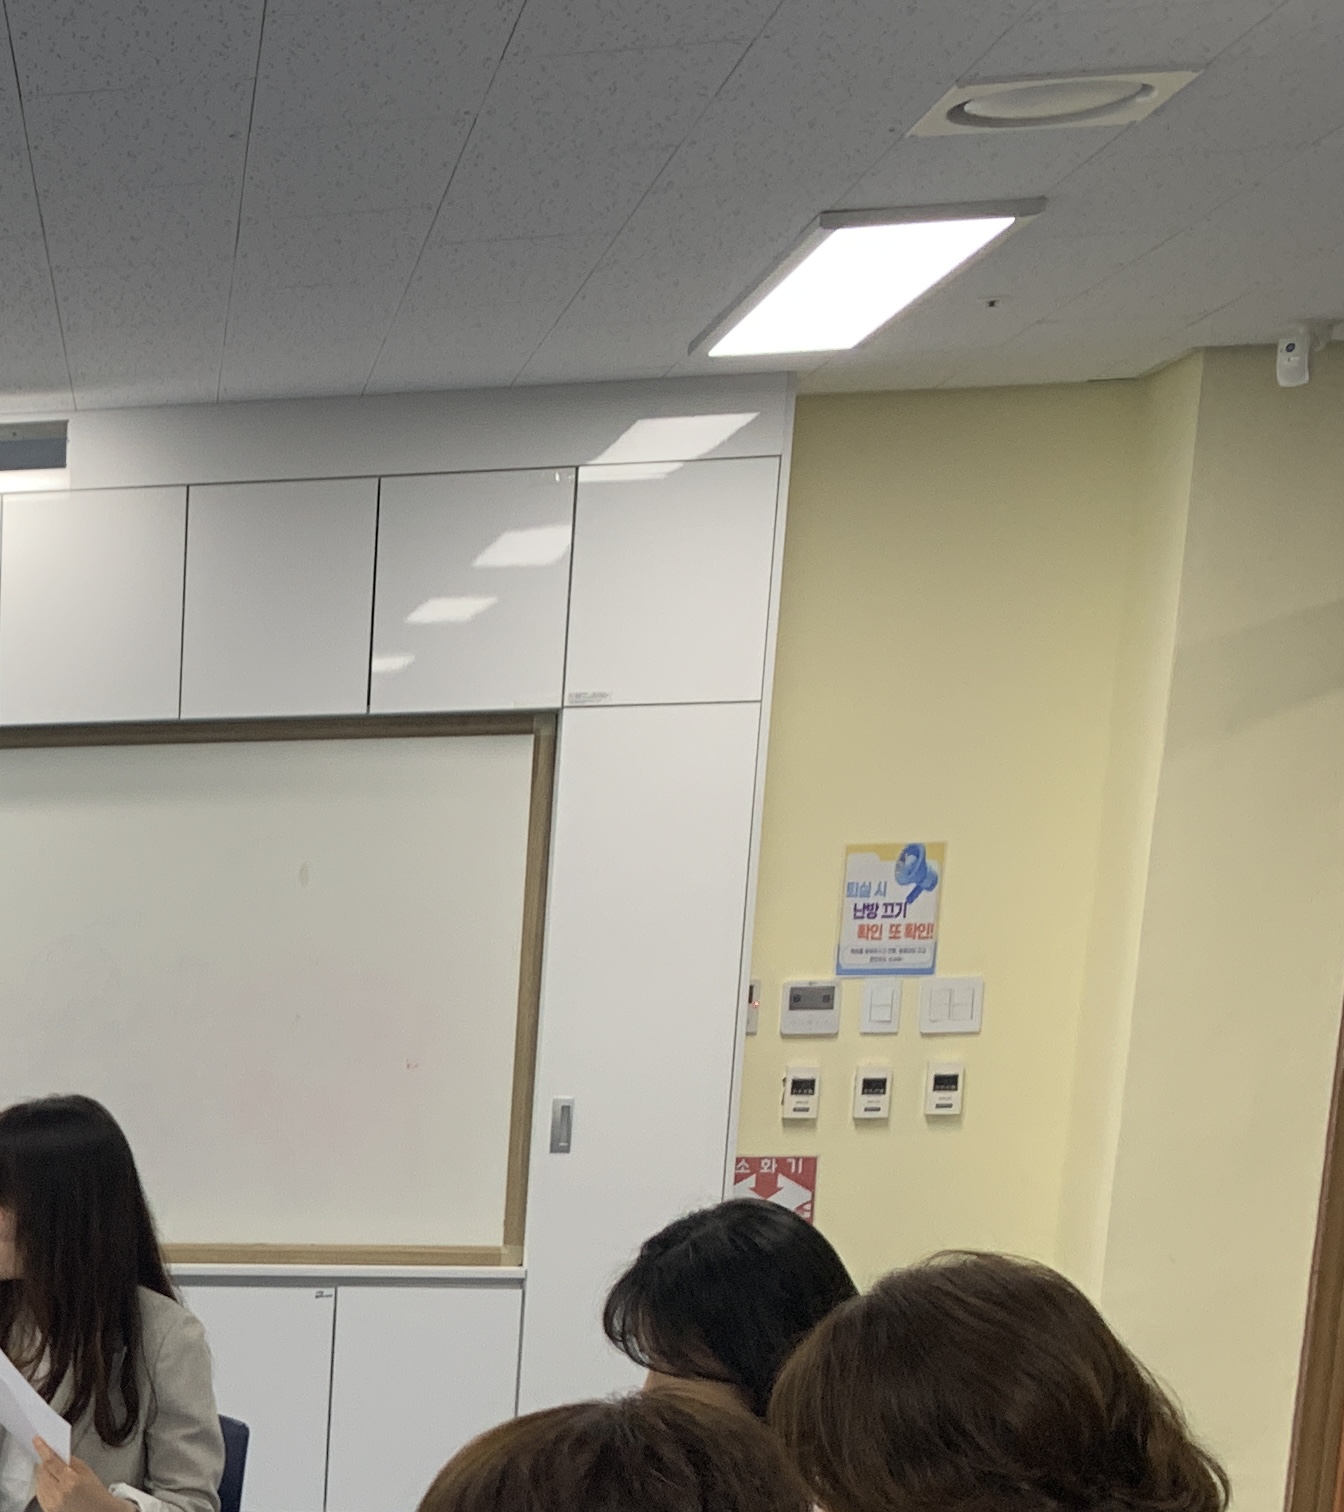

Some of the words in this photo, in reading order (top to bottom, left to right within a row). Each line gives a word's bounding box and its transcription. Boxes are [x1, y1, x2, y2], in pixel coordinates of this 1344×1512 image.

[853, 902, 880, 920] 난방
[881, 901, 907, 919] 끄기
[857, 923, 883, 941] 확인
[889, 923, 902, 940] 또
[905, 922, 935, 940] 확인!
